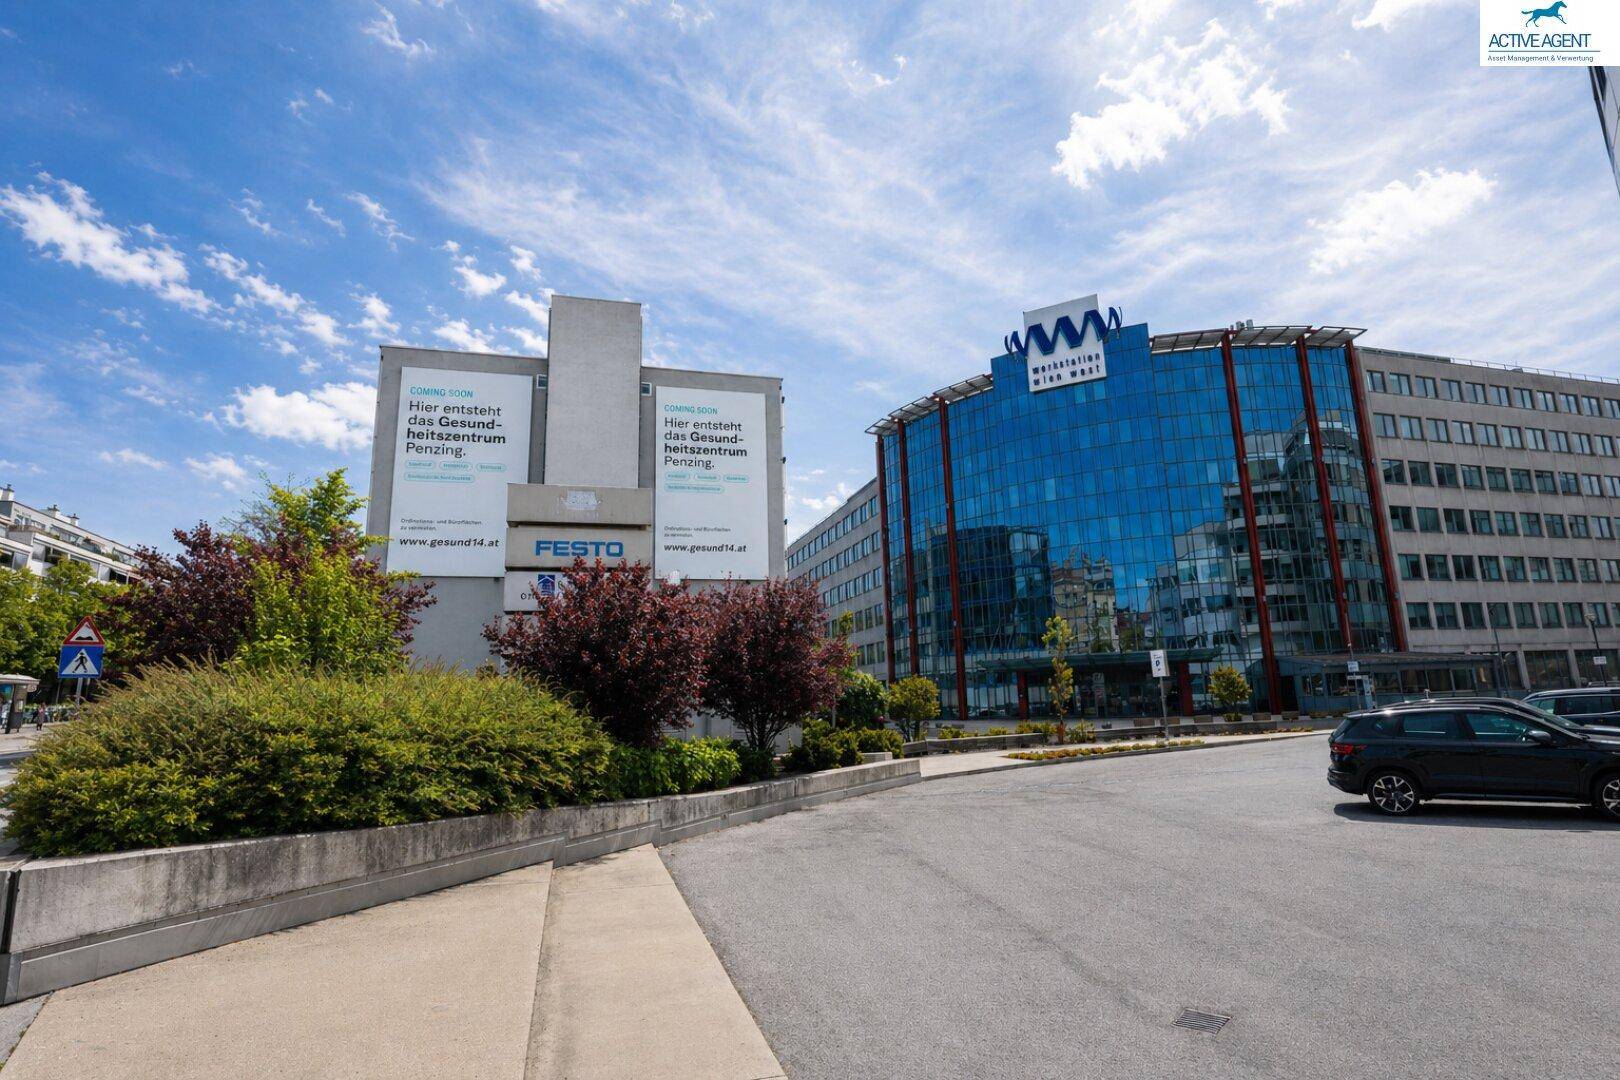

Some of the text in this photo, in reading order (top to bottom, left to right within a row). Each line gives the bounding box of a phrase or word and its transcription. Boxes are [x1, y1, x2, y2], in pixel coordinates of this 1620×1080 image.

[1032, 353, 1100, 374] workstation
[1033, 364, 1101, 386] wien west
[410, 386, 473, 398] COMING SOON
[409, 400, 502, 416] Hier entsteht
[664, 404, 718, 414] COMING SOON
[408, 415, 502, 430] das Gesund-
[664, 417, 742, 431] Hier entsteht
[406, 428, 506, 444] heitszentrum
[664, 430, 744, 444] das Gesund-
[406, 442, 466, 459] Penzing.
[664, 443, 748, 456] heitszentrum
[664, 456, 715, 470] Penzing.
[400, 538, 499, 549] www.gesund14.at
[535, 540, 624, 557] FESTO
[664, 544, 747, 553] www.gesund14.at
